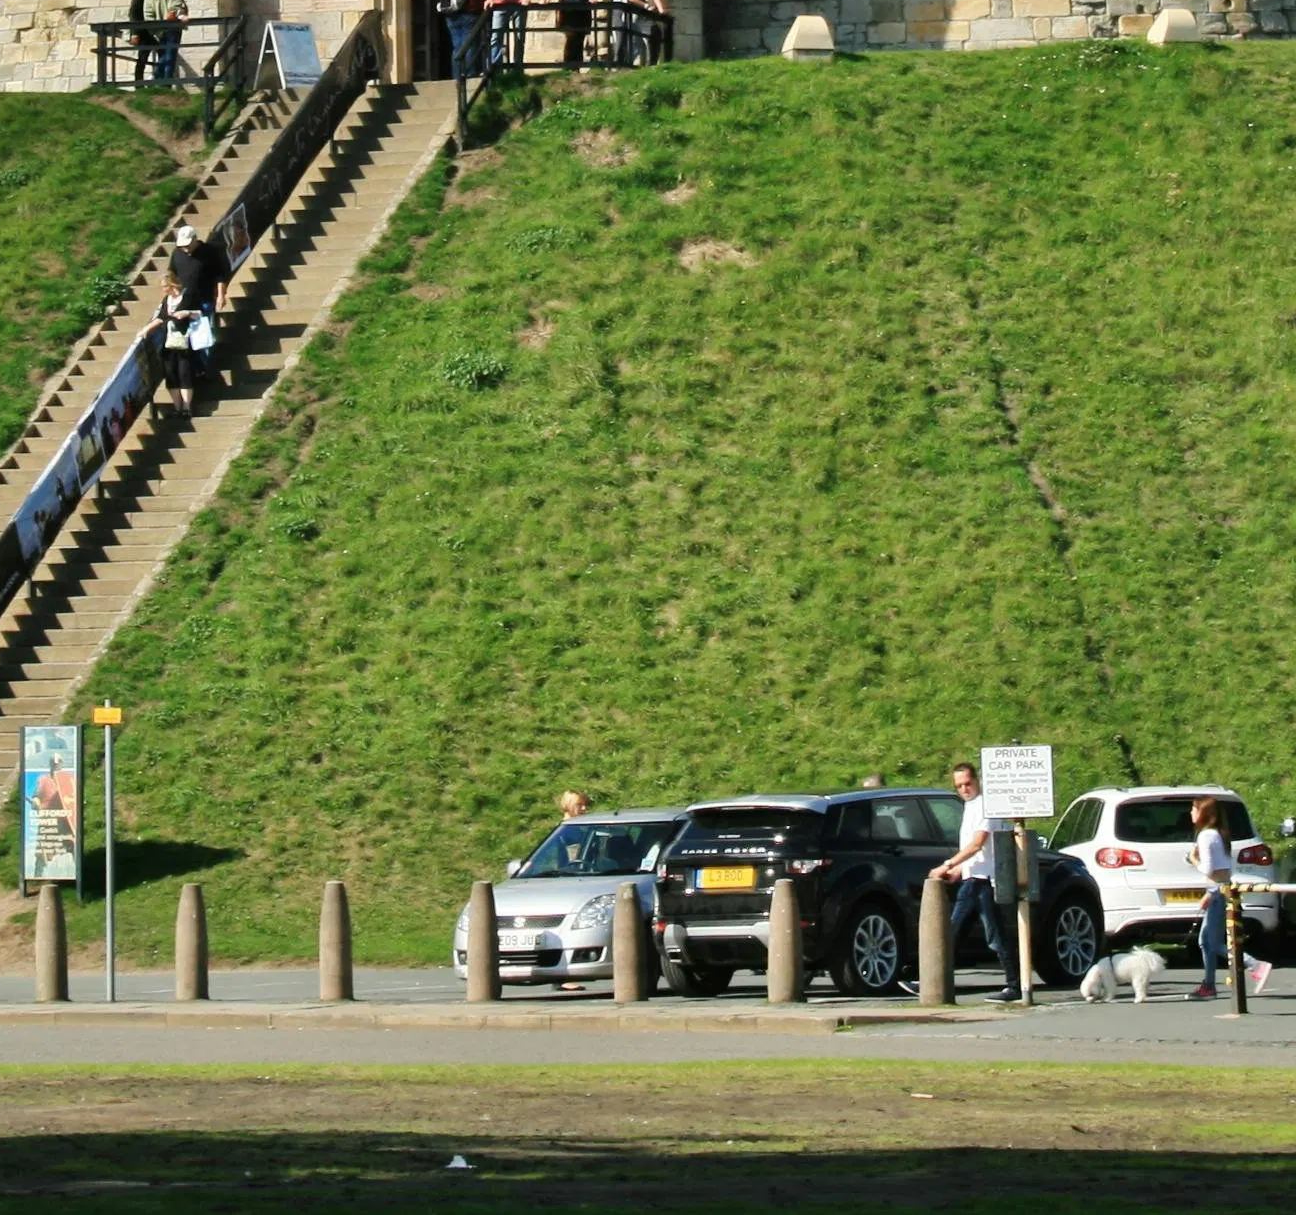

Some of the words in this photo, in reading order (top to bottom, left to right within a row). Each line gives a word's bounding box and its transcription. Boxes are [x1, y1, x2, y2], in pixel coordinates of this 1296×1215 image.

[995, 749, 1038, 758] PRIVATE
[989, 761, 1012, 770] CAR
[1016, 760, 1045, 769] PARK
